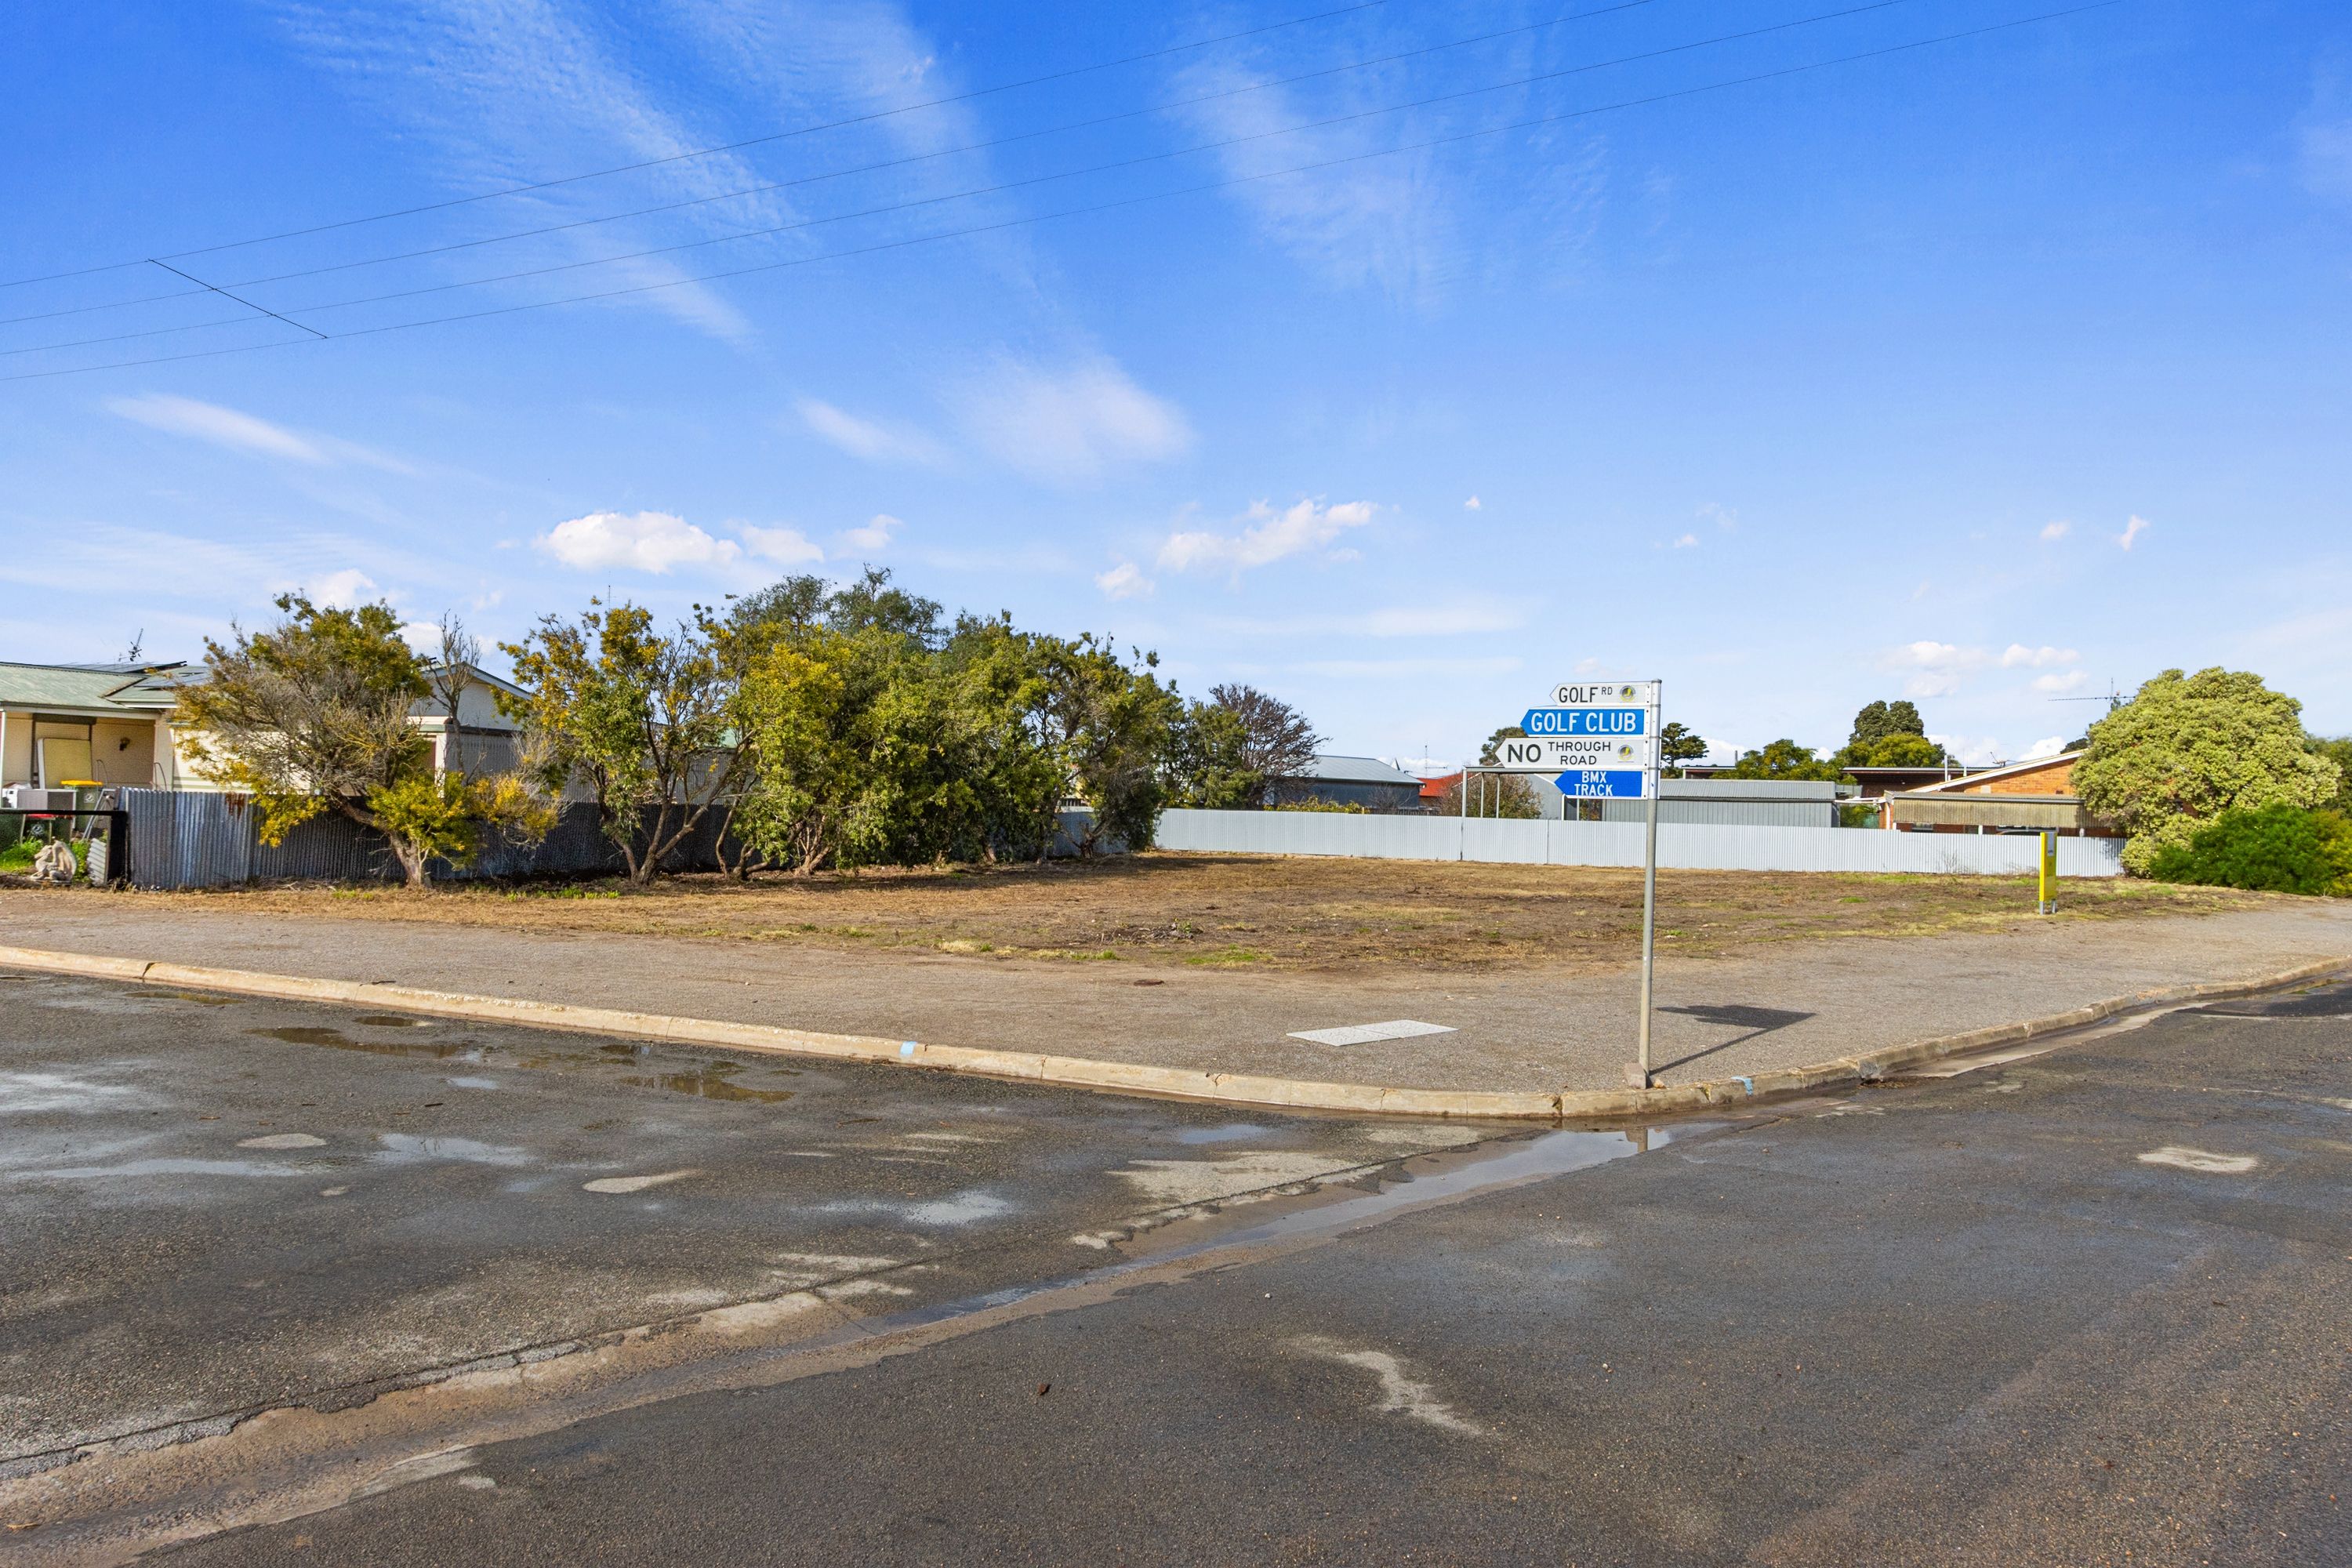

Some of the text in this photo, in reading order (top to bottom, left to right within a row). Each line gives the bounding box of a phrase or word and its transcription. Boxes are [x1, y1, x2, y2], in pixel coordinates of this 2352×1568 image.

[1559, 687, 1613, 703] GOLF RD
[1531, 712, 1636, 732] GOLF CLUB
[1507, 741, 1611, 763] NO THROUGH
[1560, 755, 1597, 765] ROAD
[1582, 771, 1607, 783] BMX
[1574, 784, 1613, 797] TRACK
